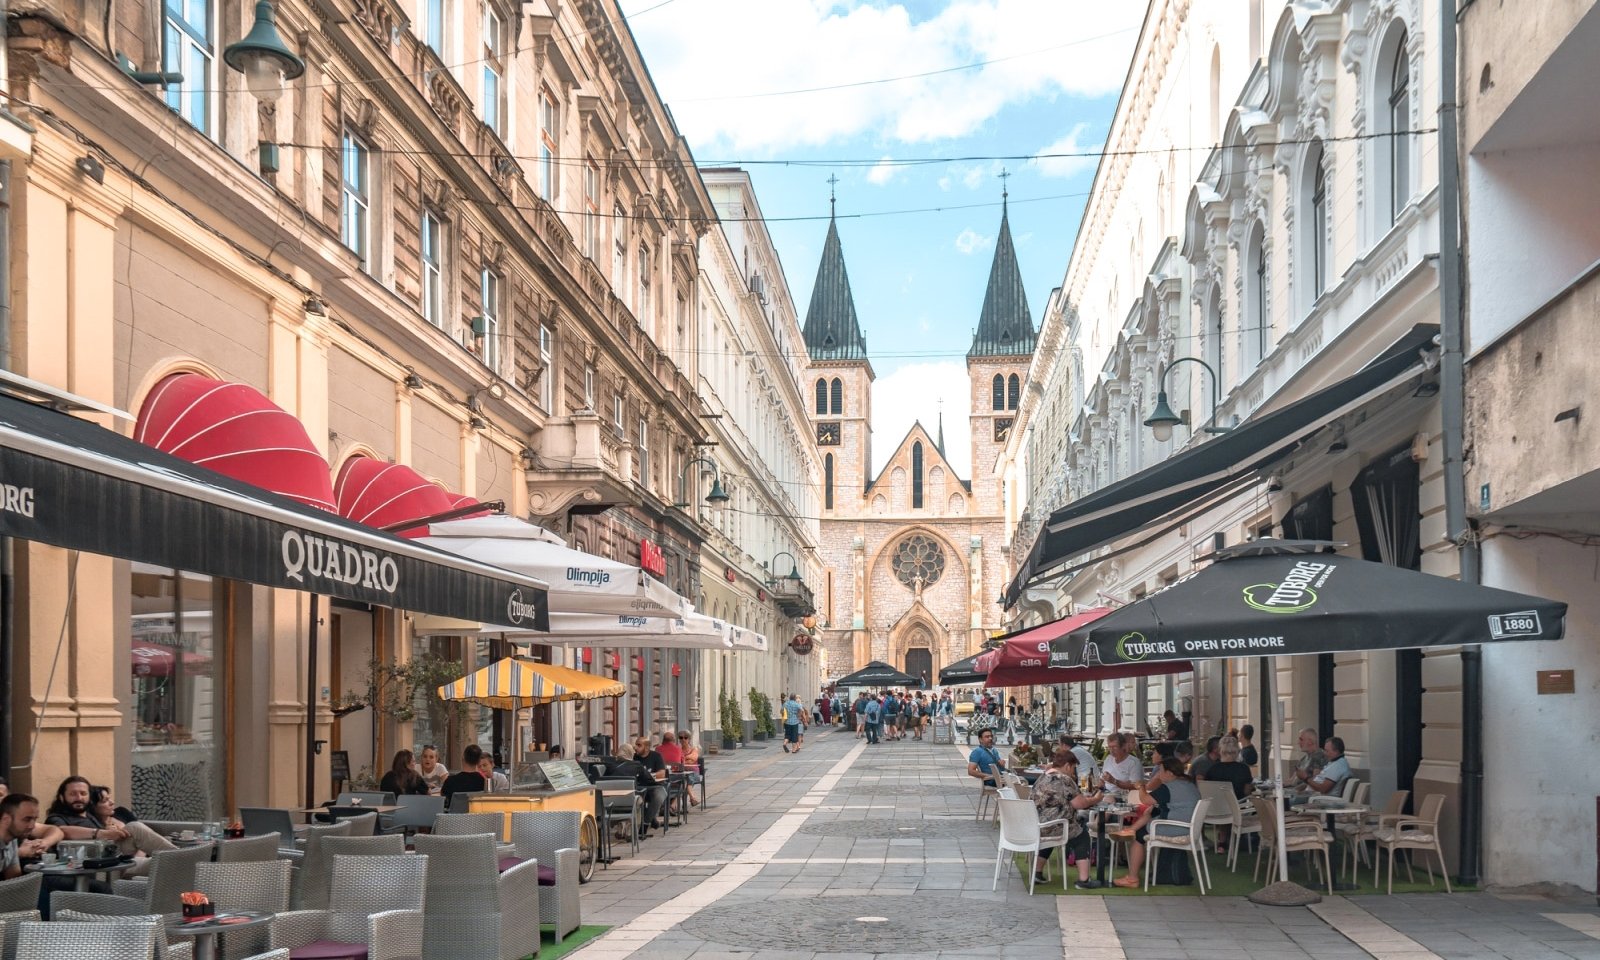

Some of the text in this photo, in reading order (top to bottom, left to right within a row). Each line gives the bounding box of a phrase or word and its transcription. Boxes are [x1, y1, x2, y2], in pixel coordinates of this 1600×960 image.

[281, 530, 399, 593] QUADRO
[566, 567, 610, 584] Olimpija
[1264, 561, 1327, 606] TUBORG
[512, 600, 535, 620] TUBORG
[1503, 619, 1534, 630] 1880
[1124, 636, 1285, 656] TUBORG OPEN FOR MORE
